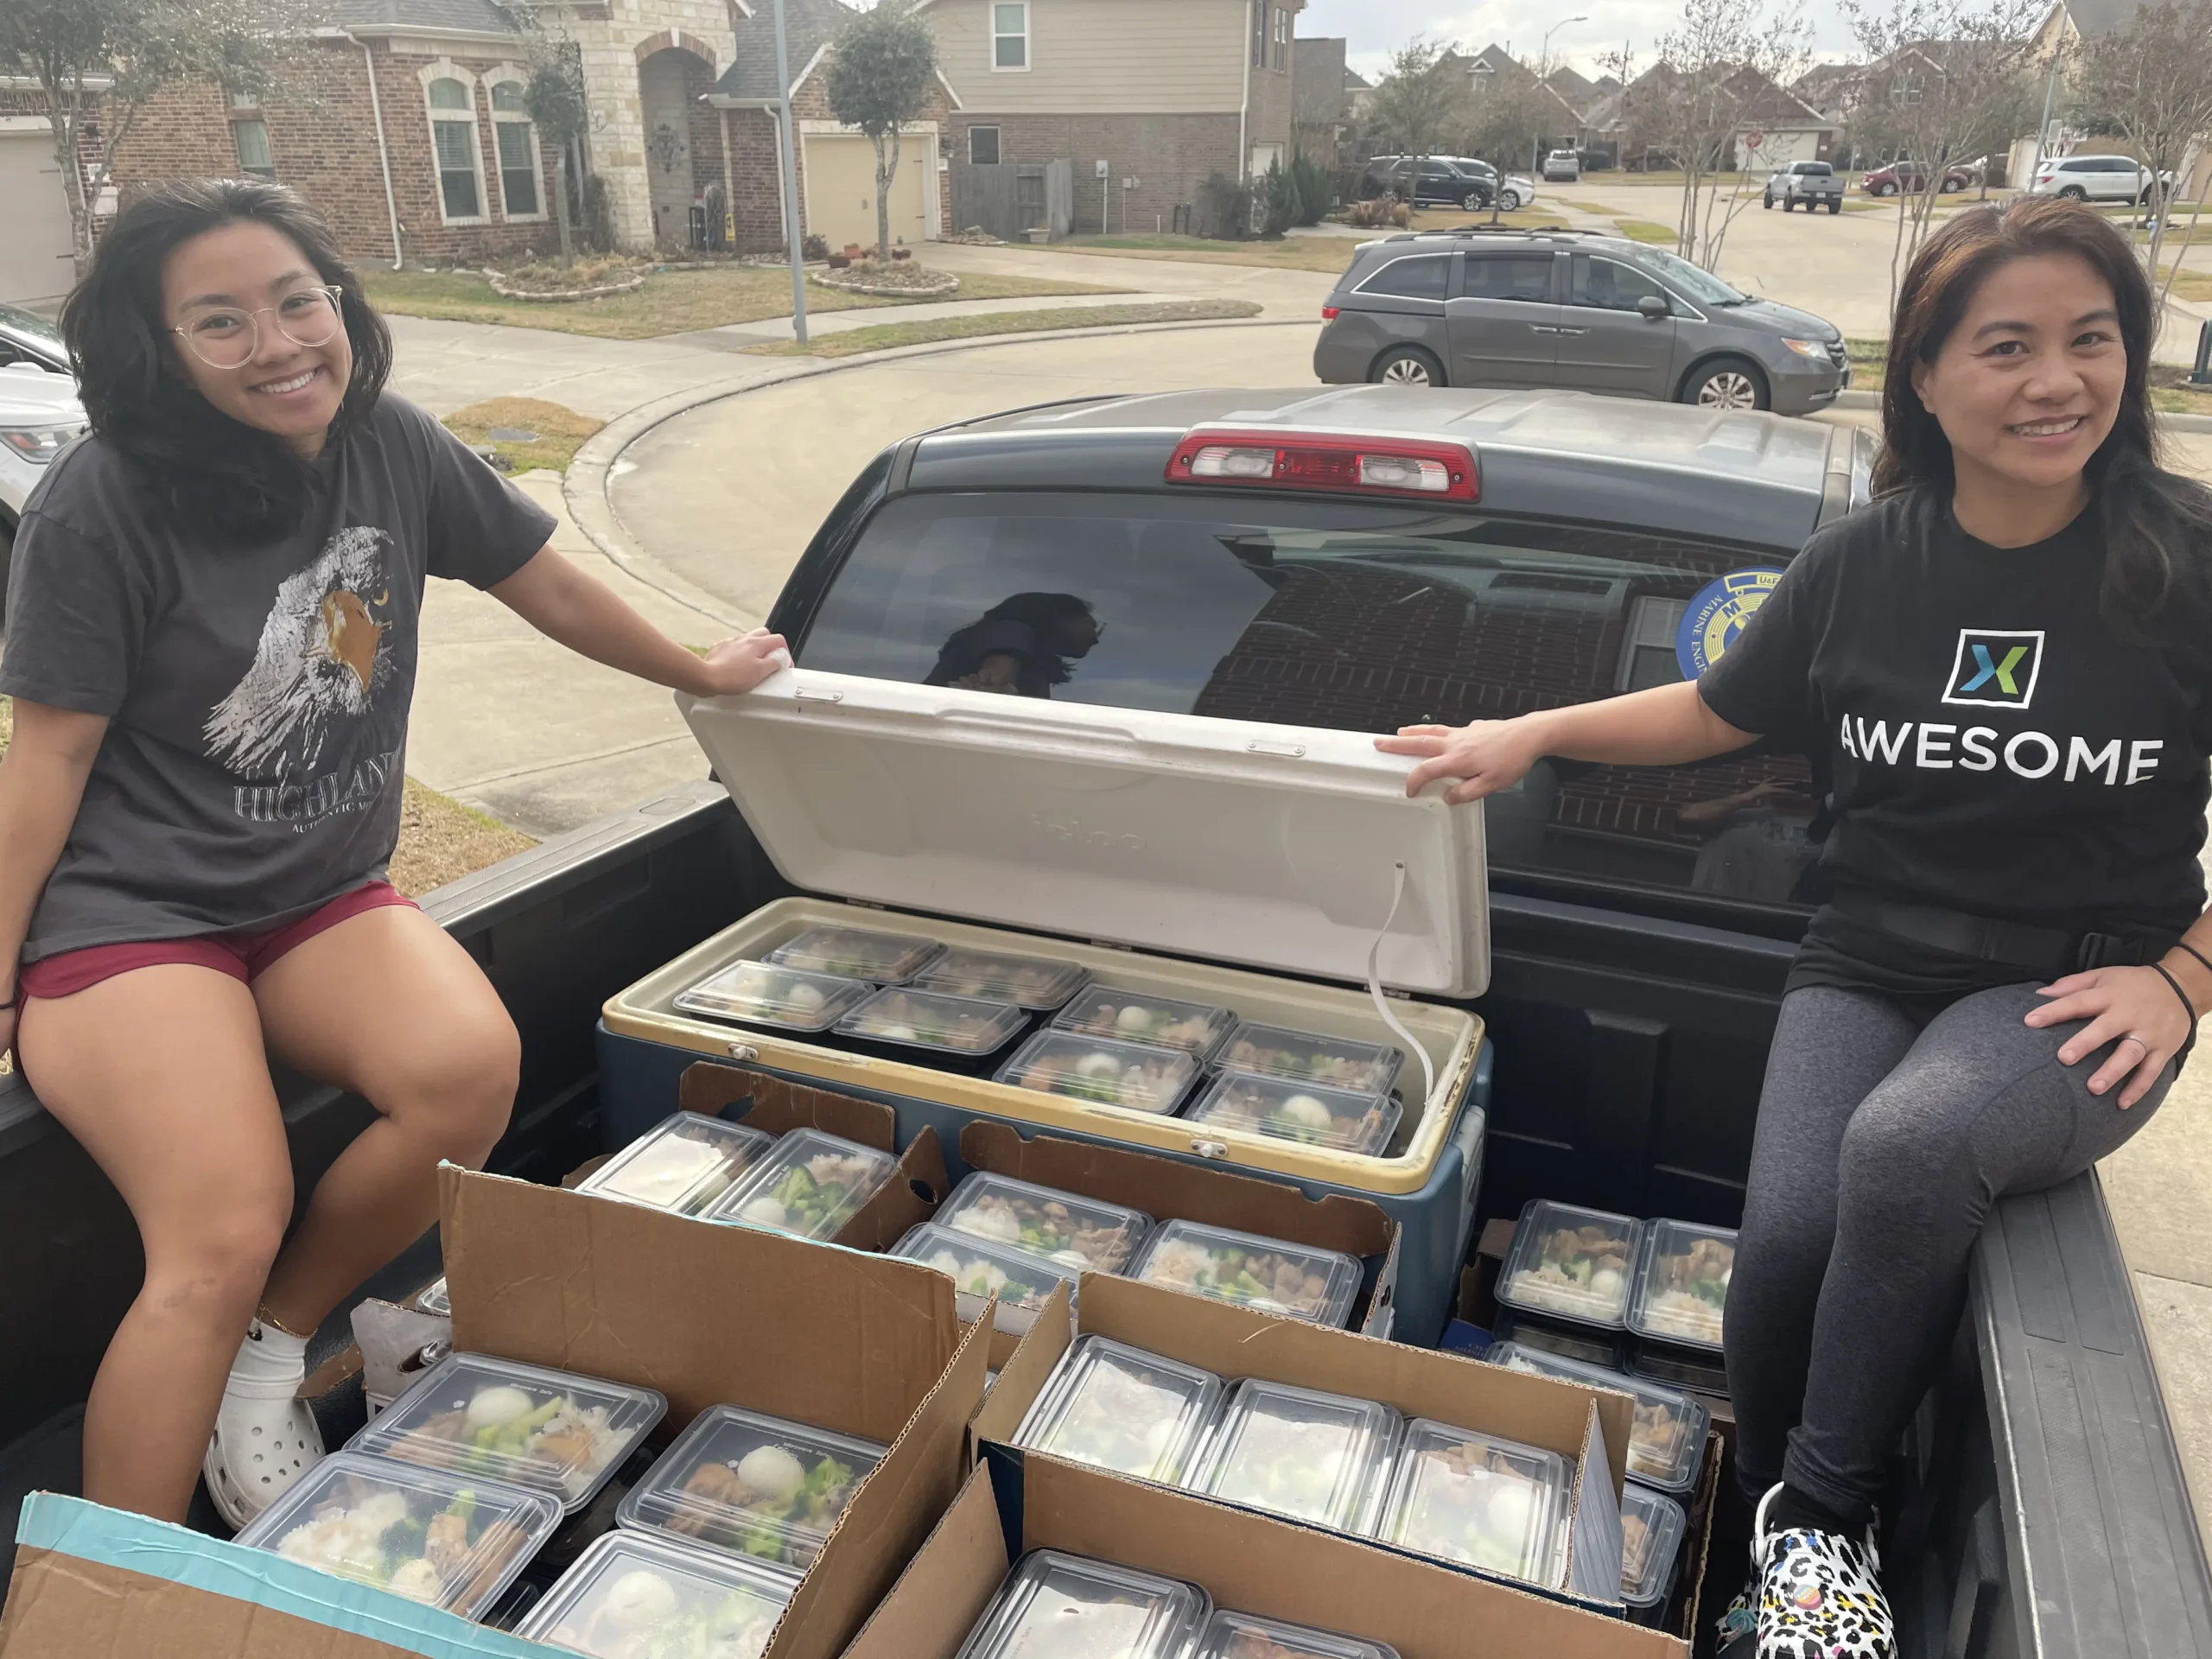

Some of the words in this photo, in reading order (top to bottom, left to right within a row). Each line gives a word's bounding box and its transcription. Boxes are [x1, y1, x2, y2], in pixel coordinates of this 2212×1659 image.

[1692, 594, 1723, 636] MARINE
[1840, 714, 2164, 785] AWESOME
[233, 751, 399, 822] HIGHLAN
